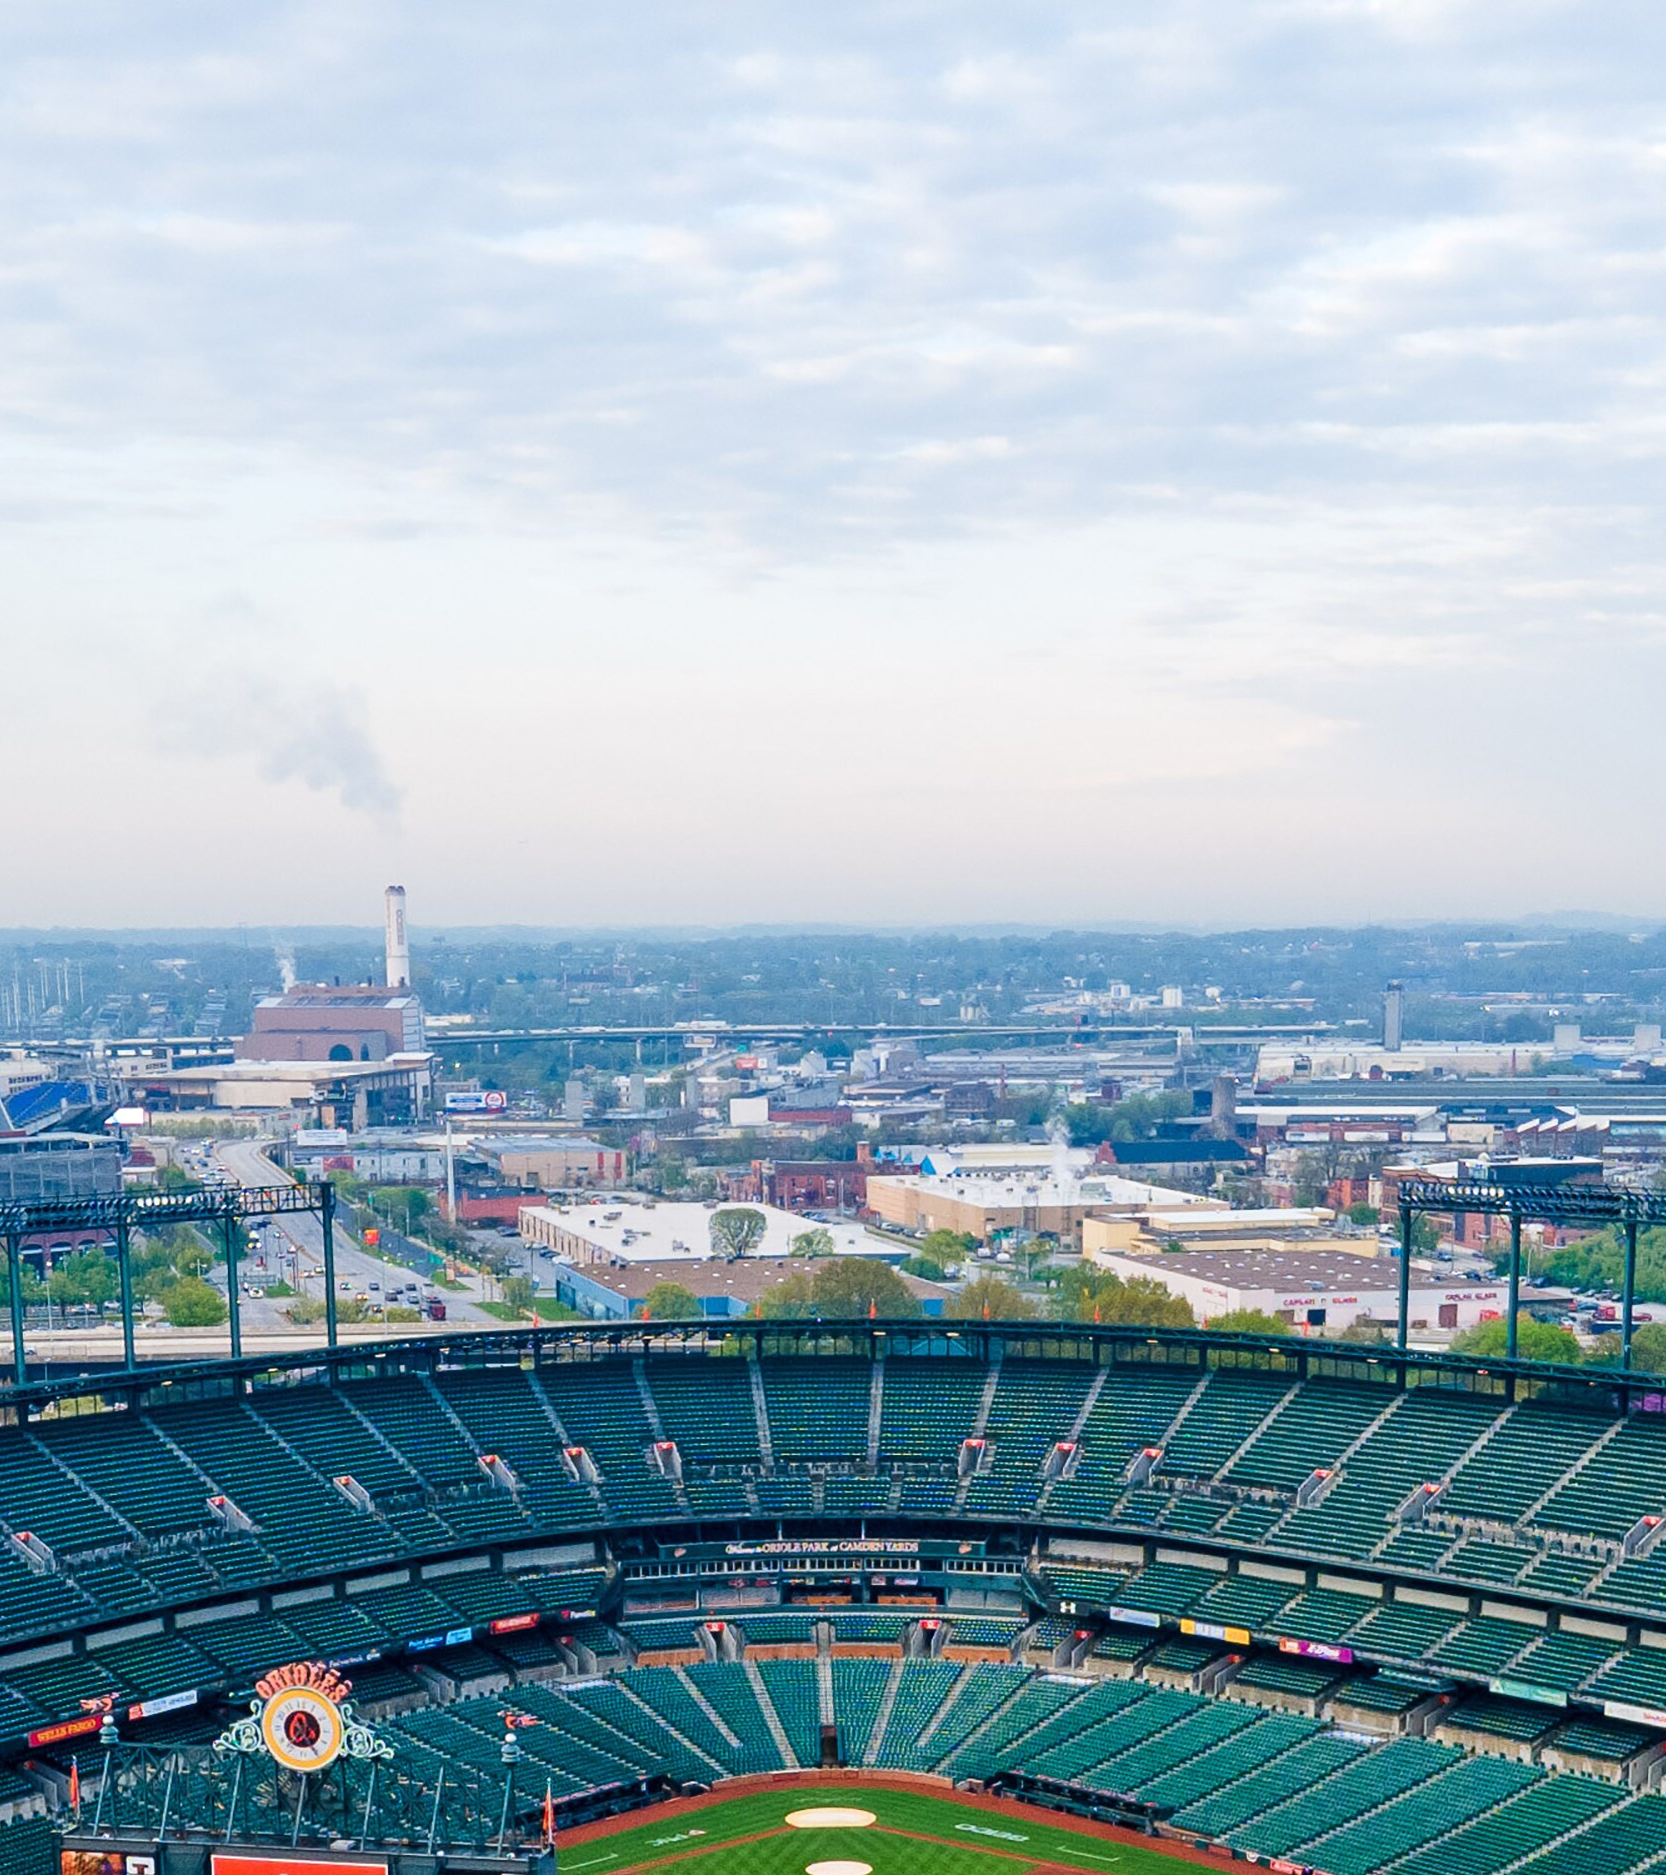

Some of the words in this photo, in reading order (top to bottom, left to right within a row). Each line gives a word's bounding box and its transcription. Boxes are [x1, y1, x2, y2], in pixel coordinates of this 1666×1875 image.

[762, 1543, 801, 1552] ORIOLE
[801, 1542, 829, 1552] PARK
[839, 1542, 884, 1552] CAMDEN
[884, 1542, 919, 1553] YARDS
[255, 1661, 353, 1704] ORIOLES
